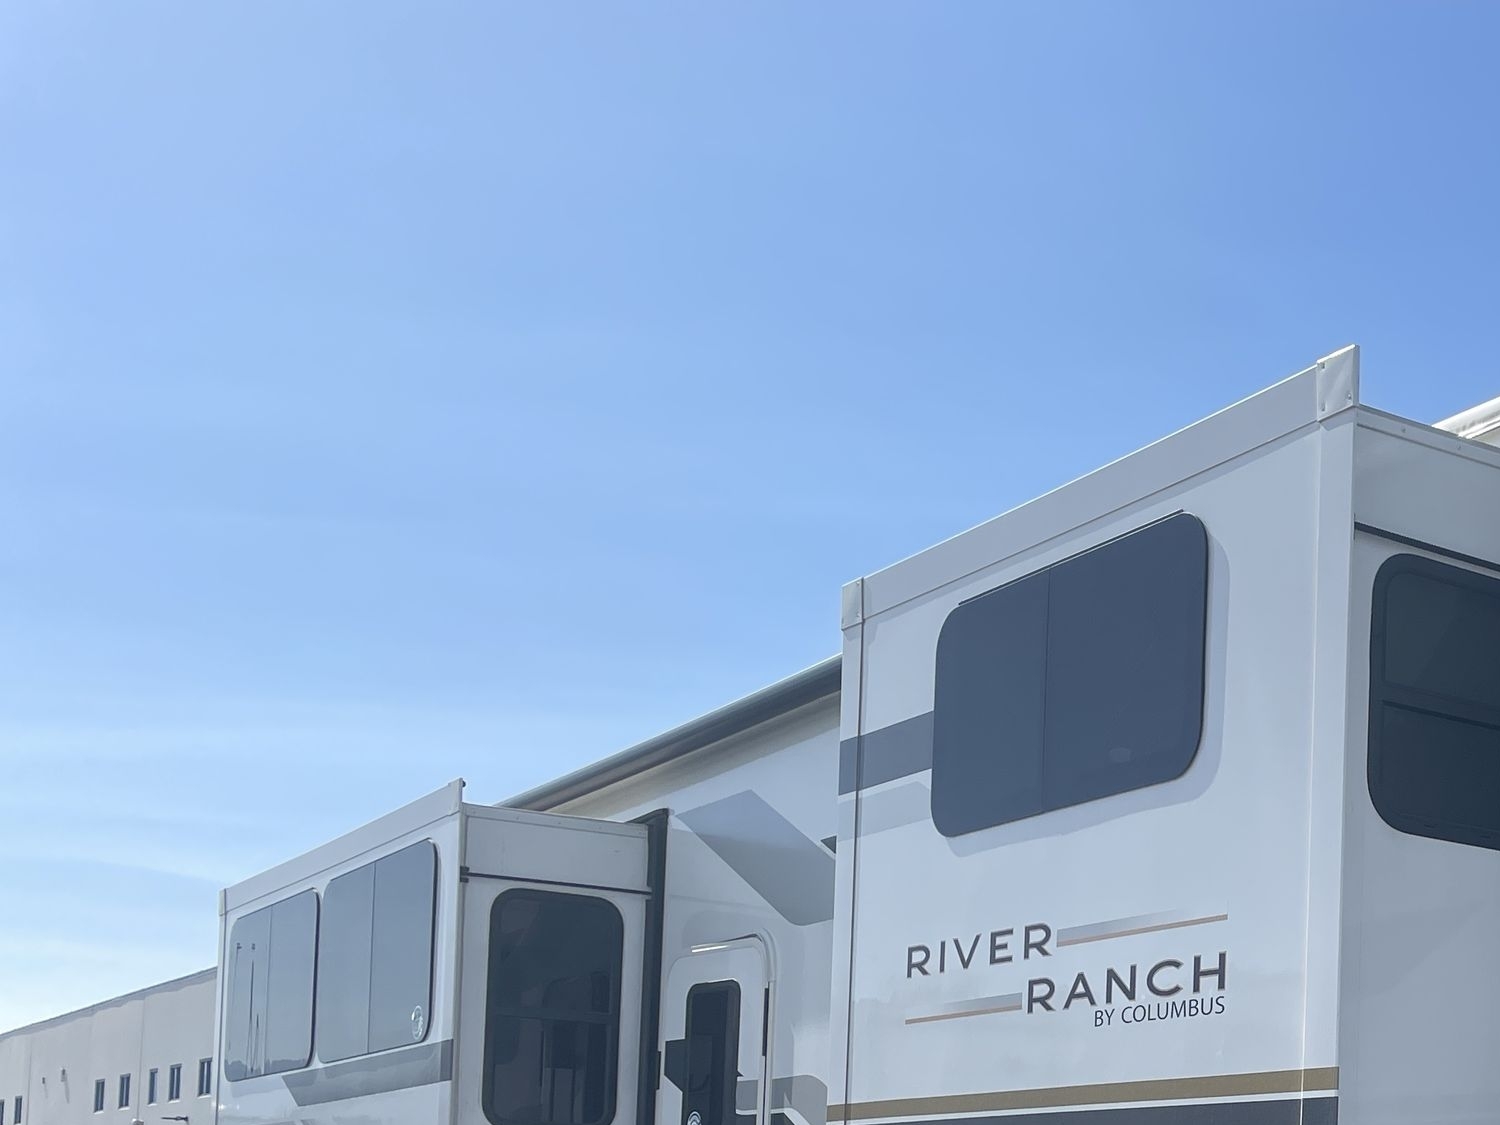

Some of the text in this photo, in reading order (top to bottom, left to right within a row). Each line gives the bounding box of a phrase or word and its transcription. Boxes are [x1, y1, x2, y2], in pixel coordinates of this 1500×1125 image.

[905, 921, 1053, 979] RIVER
[1026, 950, 1228, 1015] RANCH
[1093, 995, 1226, 1028] BY COLUMBUS
